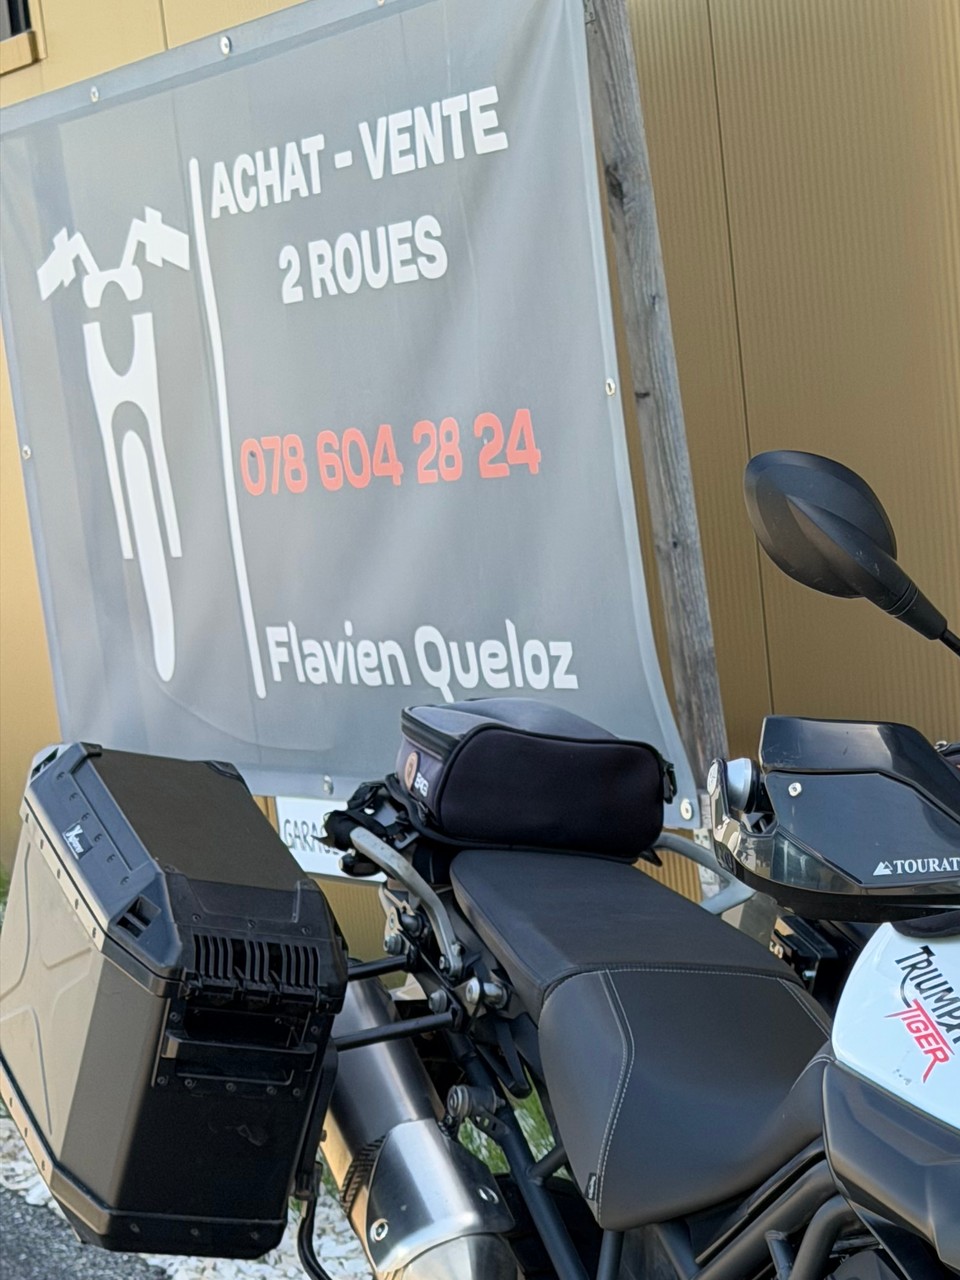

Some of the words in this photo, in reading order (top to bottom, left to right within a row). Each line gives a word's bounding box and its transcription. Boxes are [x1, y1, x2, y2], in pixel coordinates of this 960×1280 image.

[211, 134, 325, 218] ACHAT
[358, 86, 508, 180] VENTE
[278, 245, 304, 304] 2
[308, 215, 448, 298] ROUES
[240, 434, 308, 496] 078
[317, 424, 404, 491] 604
[412, 417, 463, 484] 28
[473, 408, 542, 479] 24
[265, 620, 412, 687] Flavien
[414, 618, 579, 703] Queloz
[284, 819, 340, 856] GARA
[884, 998, 955, 1084] TIGER
